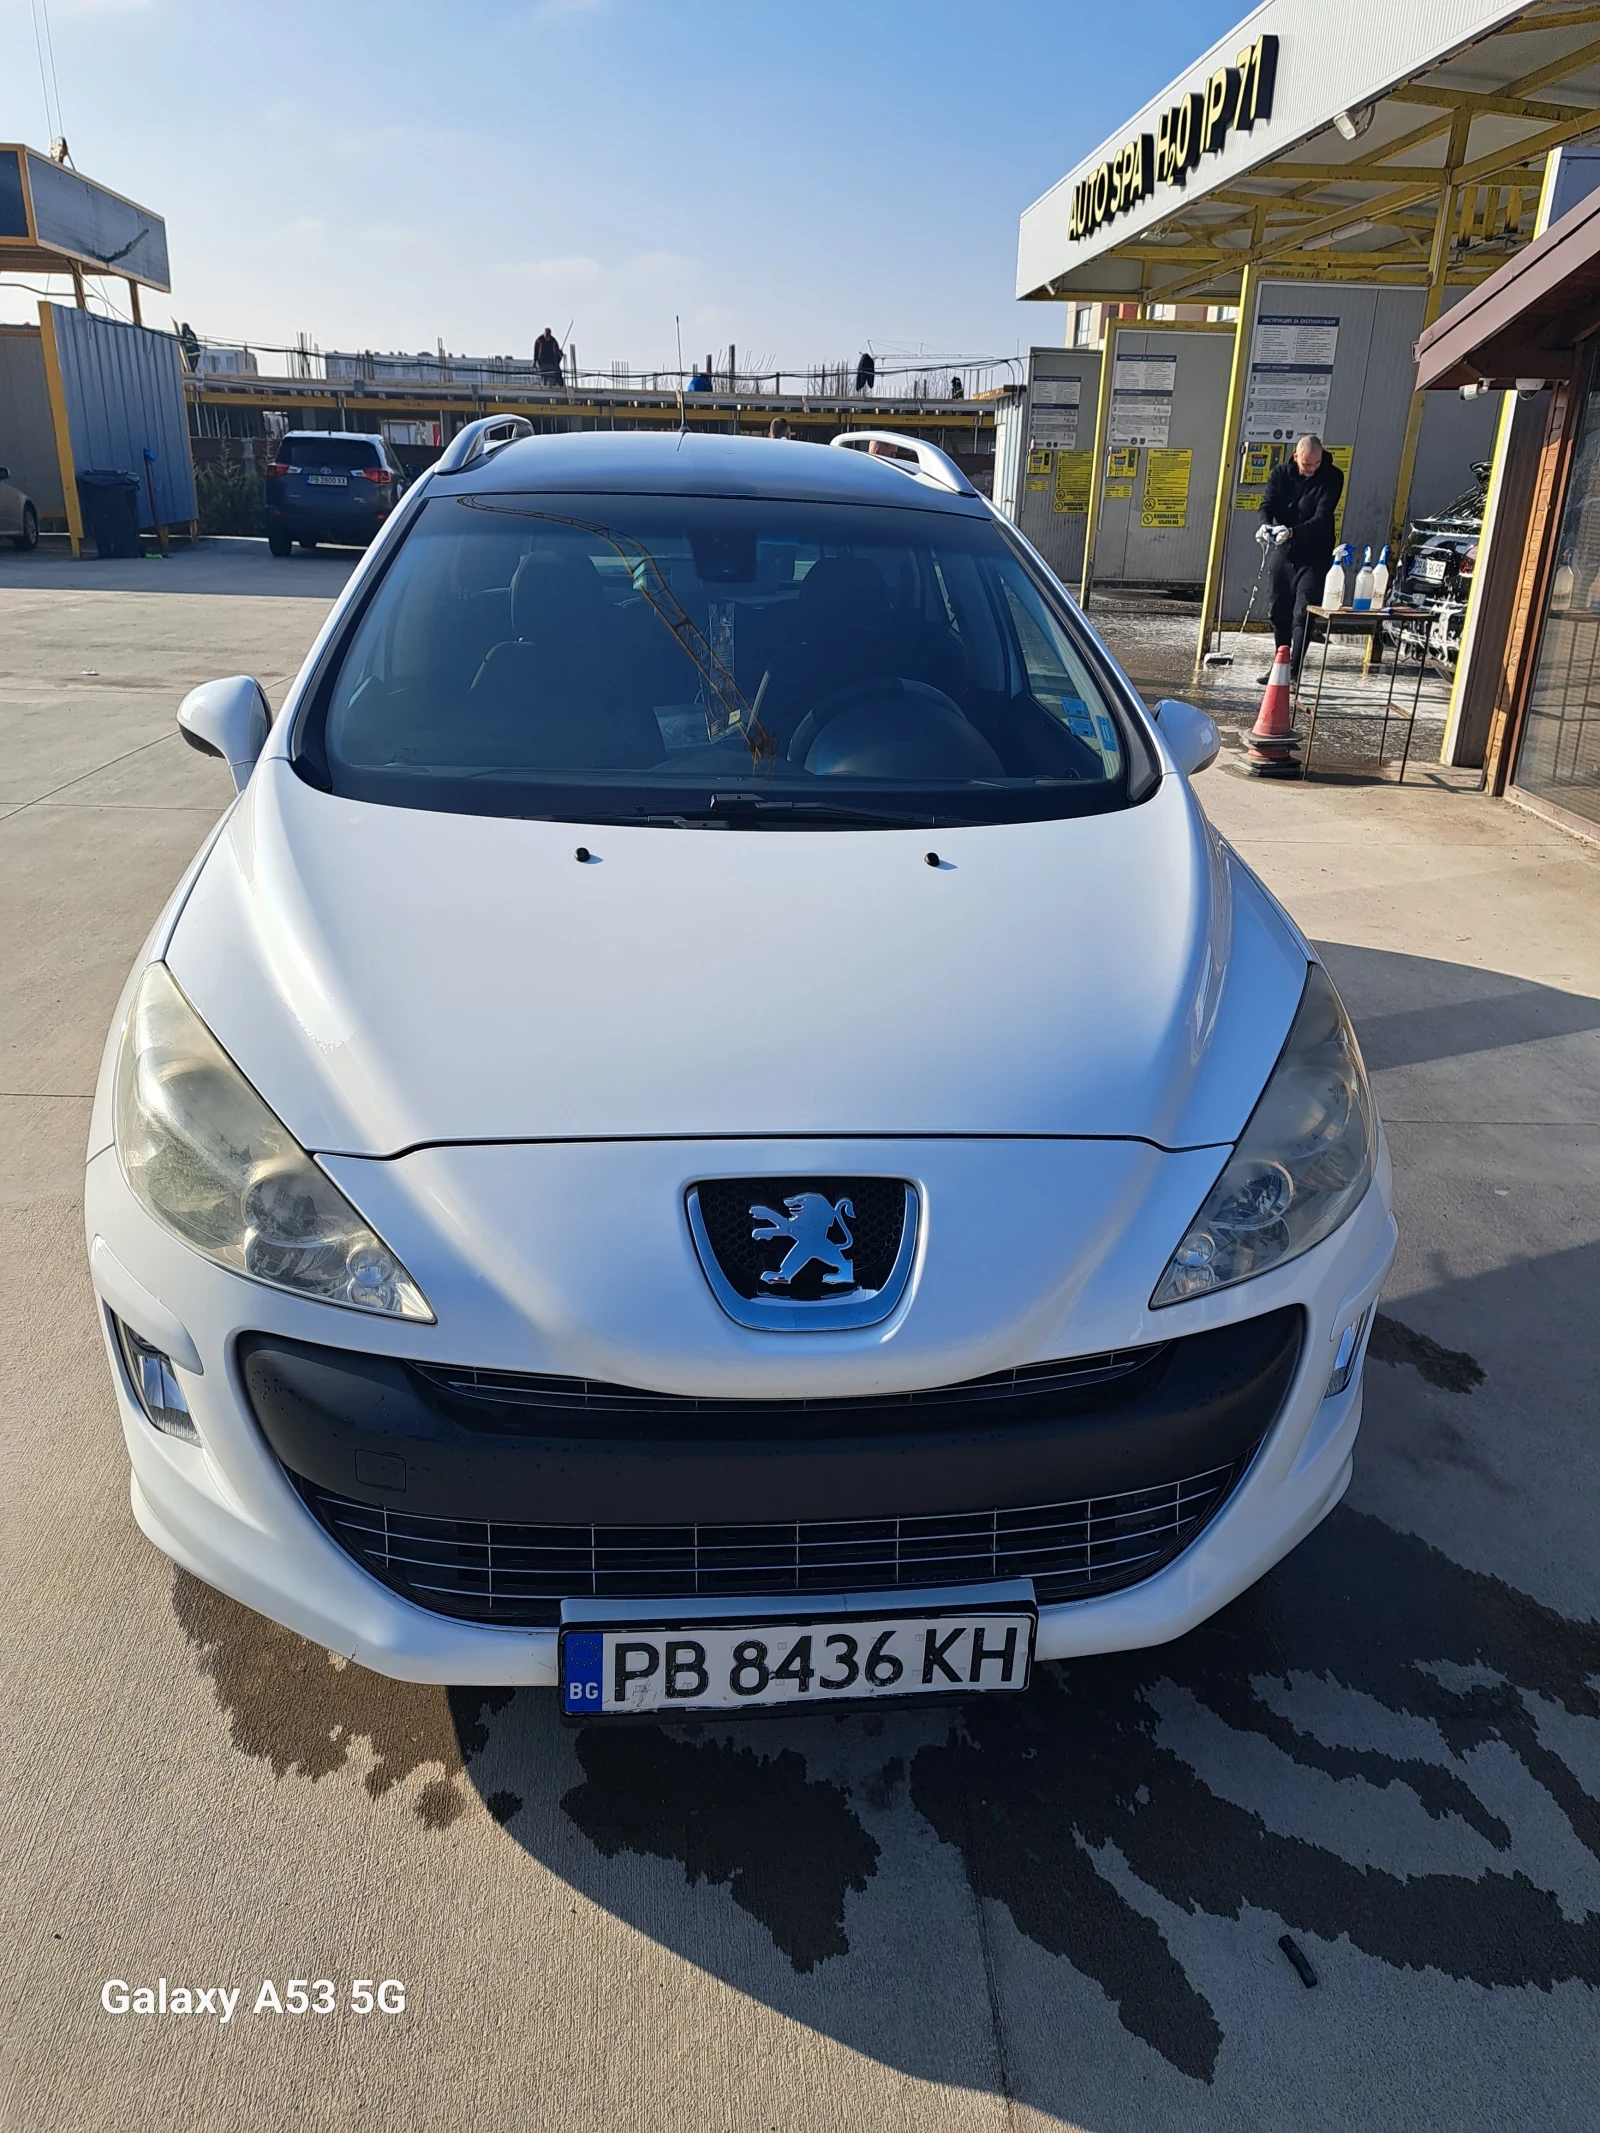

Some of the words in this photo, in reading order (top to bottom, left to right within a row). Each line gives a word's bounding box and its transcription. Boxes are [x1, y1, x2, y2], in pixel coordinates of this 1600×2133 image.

[1067, 161, 1112, 241] AUTO
[1110, 133, 1150, 213] SPA
[1233, 34, 1275, 131] 71
[569, 1682, 600, 1700] BG
[613, 1640, 708, 1702] PB
[729, 1630, 901, 1696] 8436
[921, 1626, 1018, 1684] KH
